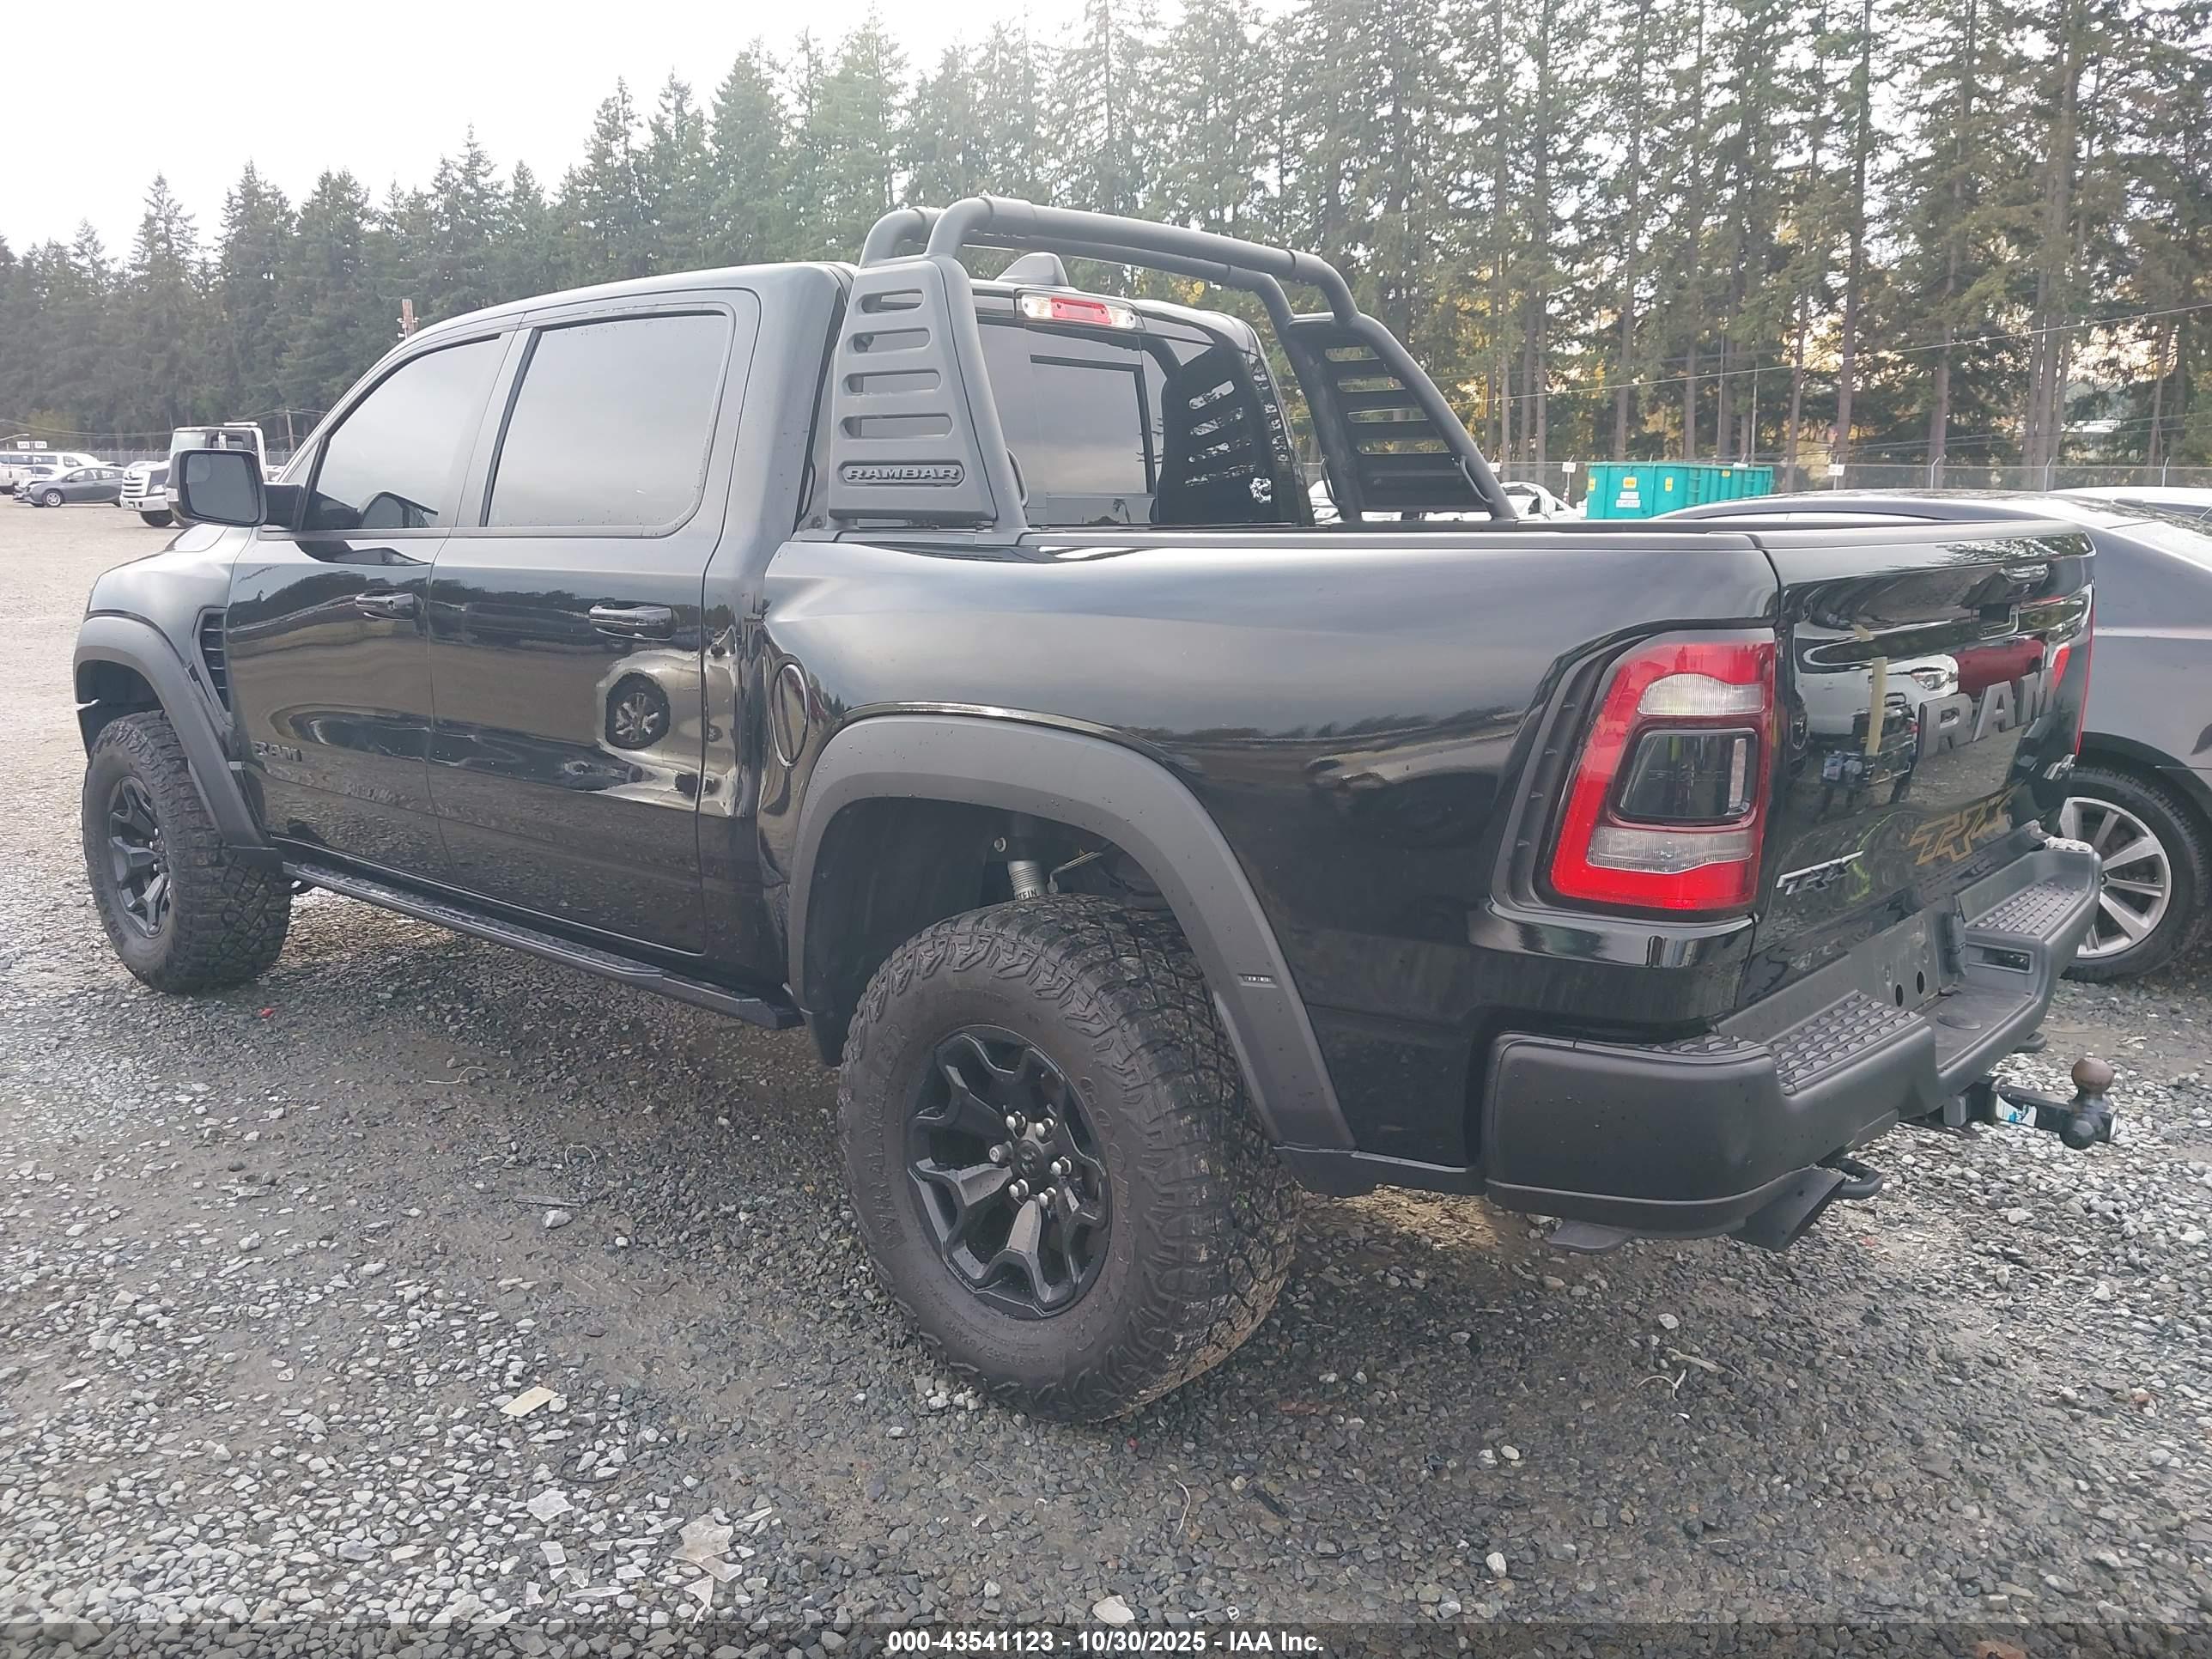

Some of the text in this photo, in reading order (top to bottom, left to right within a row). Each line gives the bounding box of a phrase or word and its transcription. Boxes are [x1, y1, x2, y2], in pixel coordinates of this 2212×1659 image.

[847, 466, 959, 481] RAMBAR
[1917, 666, 2056, 761] RAM
[1775, 849, 1865, 896] TRX
